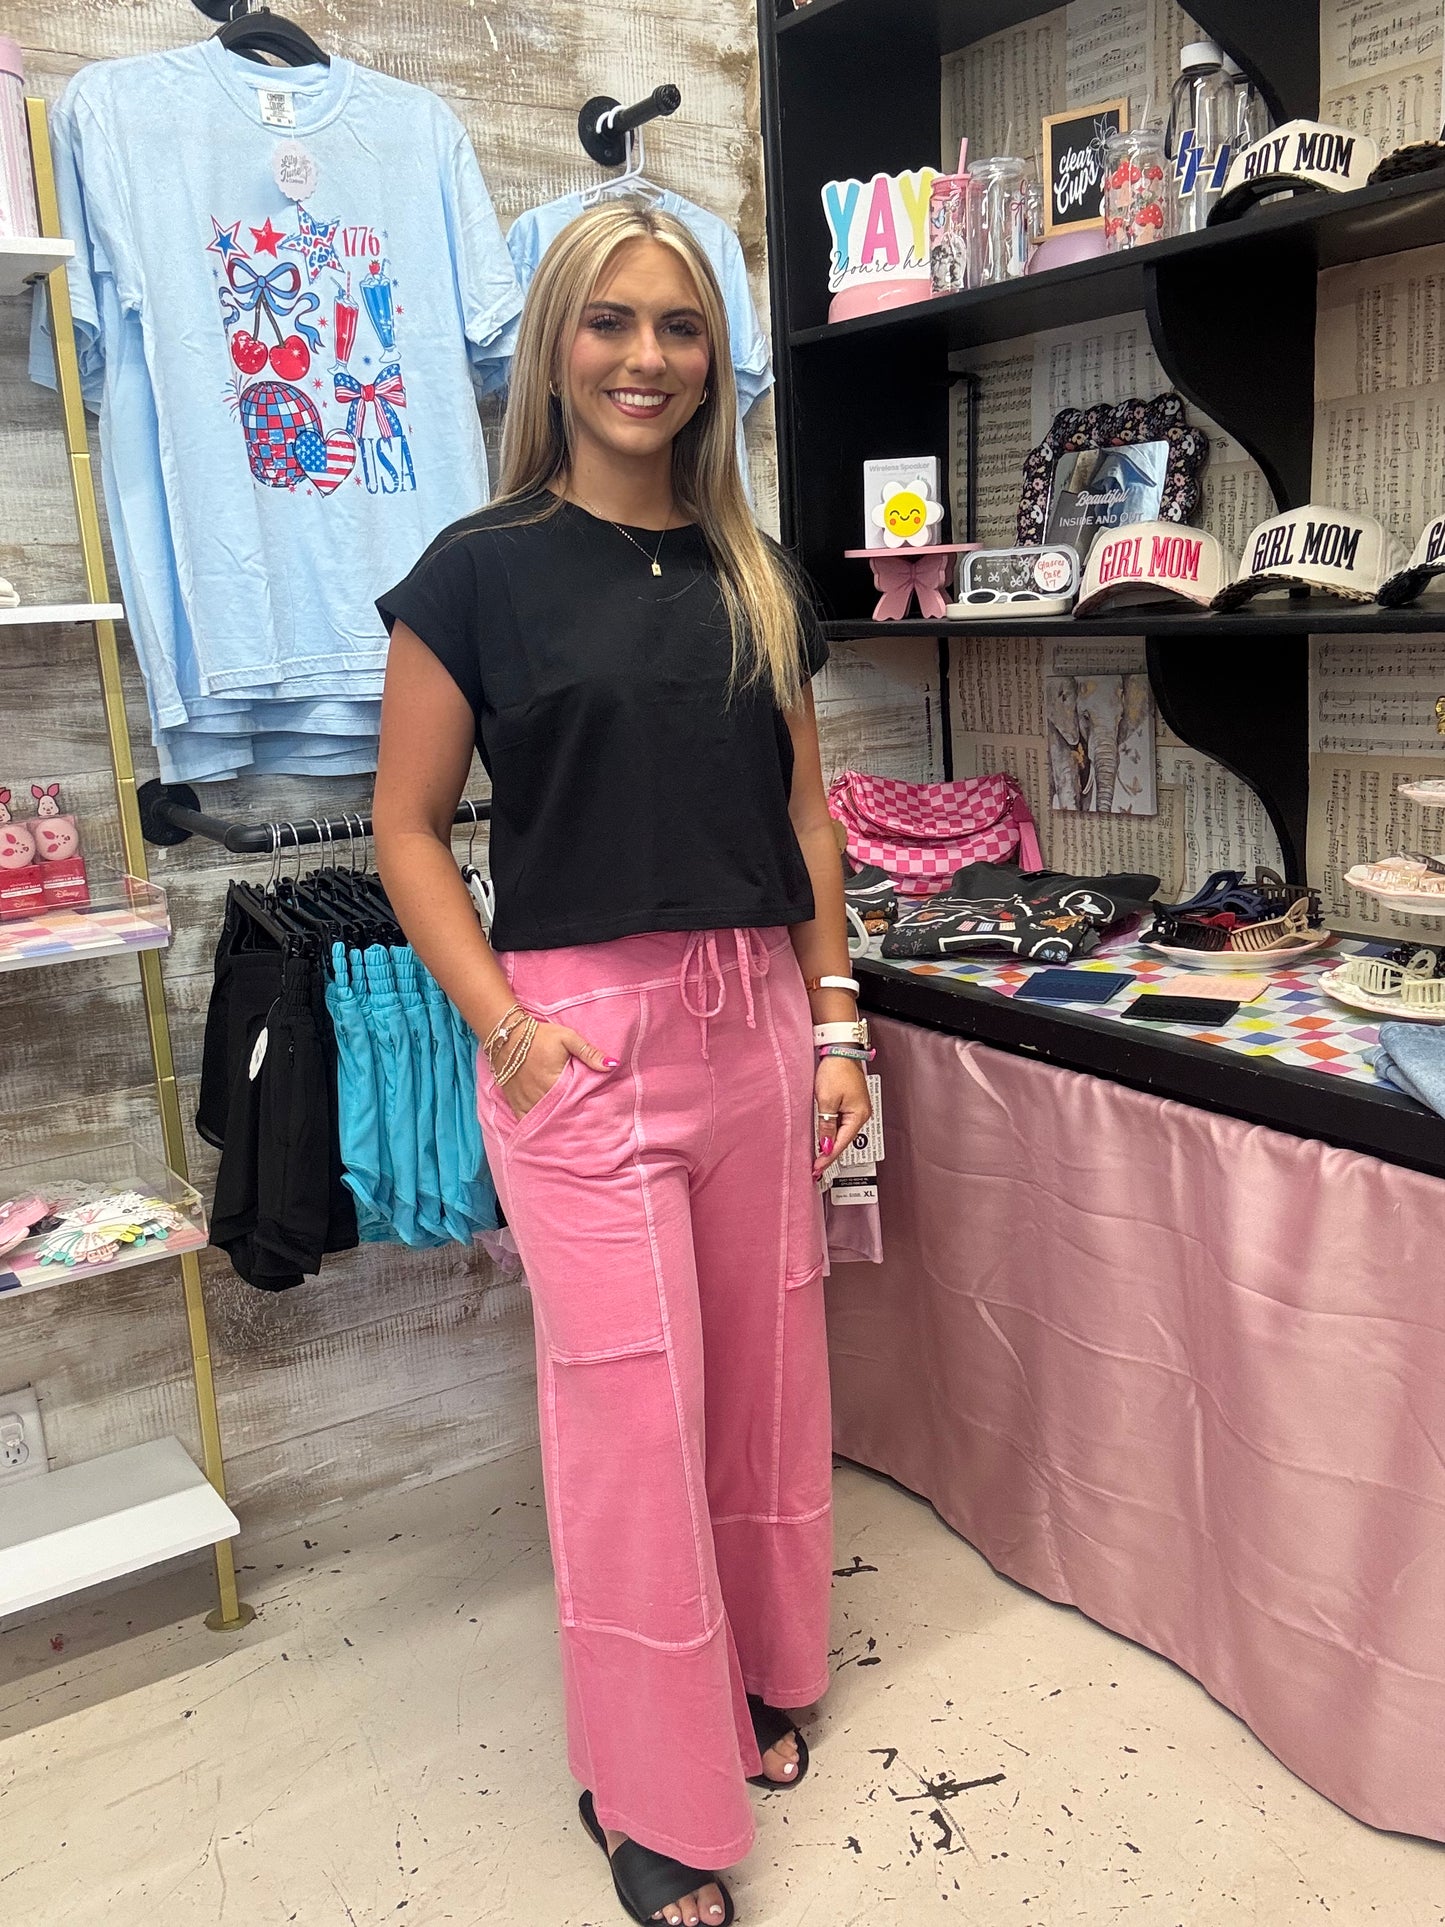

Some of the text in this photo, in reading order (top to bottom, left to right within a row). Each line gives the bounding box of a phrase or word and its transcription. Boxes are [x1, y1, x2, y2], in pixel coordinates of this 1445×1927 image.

[1059, 146, 1094, 175] clear
[1244, 132, 1356, 180] BOY MOM
[1053, 160, 1099, 214] Cups
[826, 171, 935, 270] YAY
[341, 226, 381, 257] 1776
[358, 434, 417, 494] USA
[869, 462, 930, 472] Wireless Speaker
[1075, 487, 1130, 508] Beautiful
[1060, 512, 1144, 527] INSIDE AND OUT
[1099, 536, 1203, 584] GIRL MOM
[1251, 522, 1363, 575] GIRL MOM
[53, 889, 80, 898] Disney
